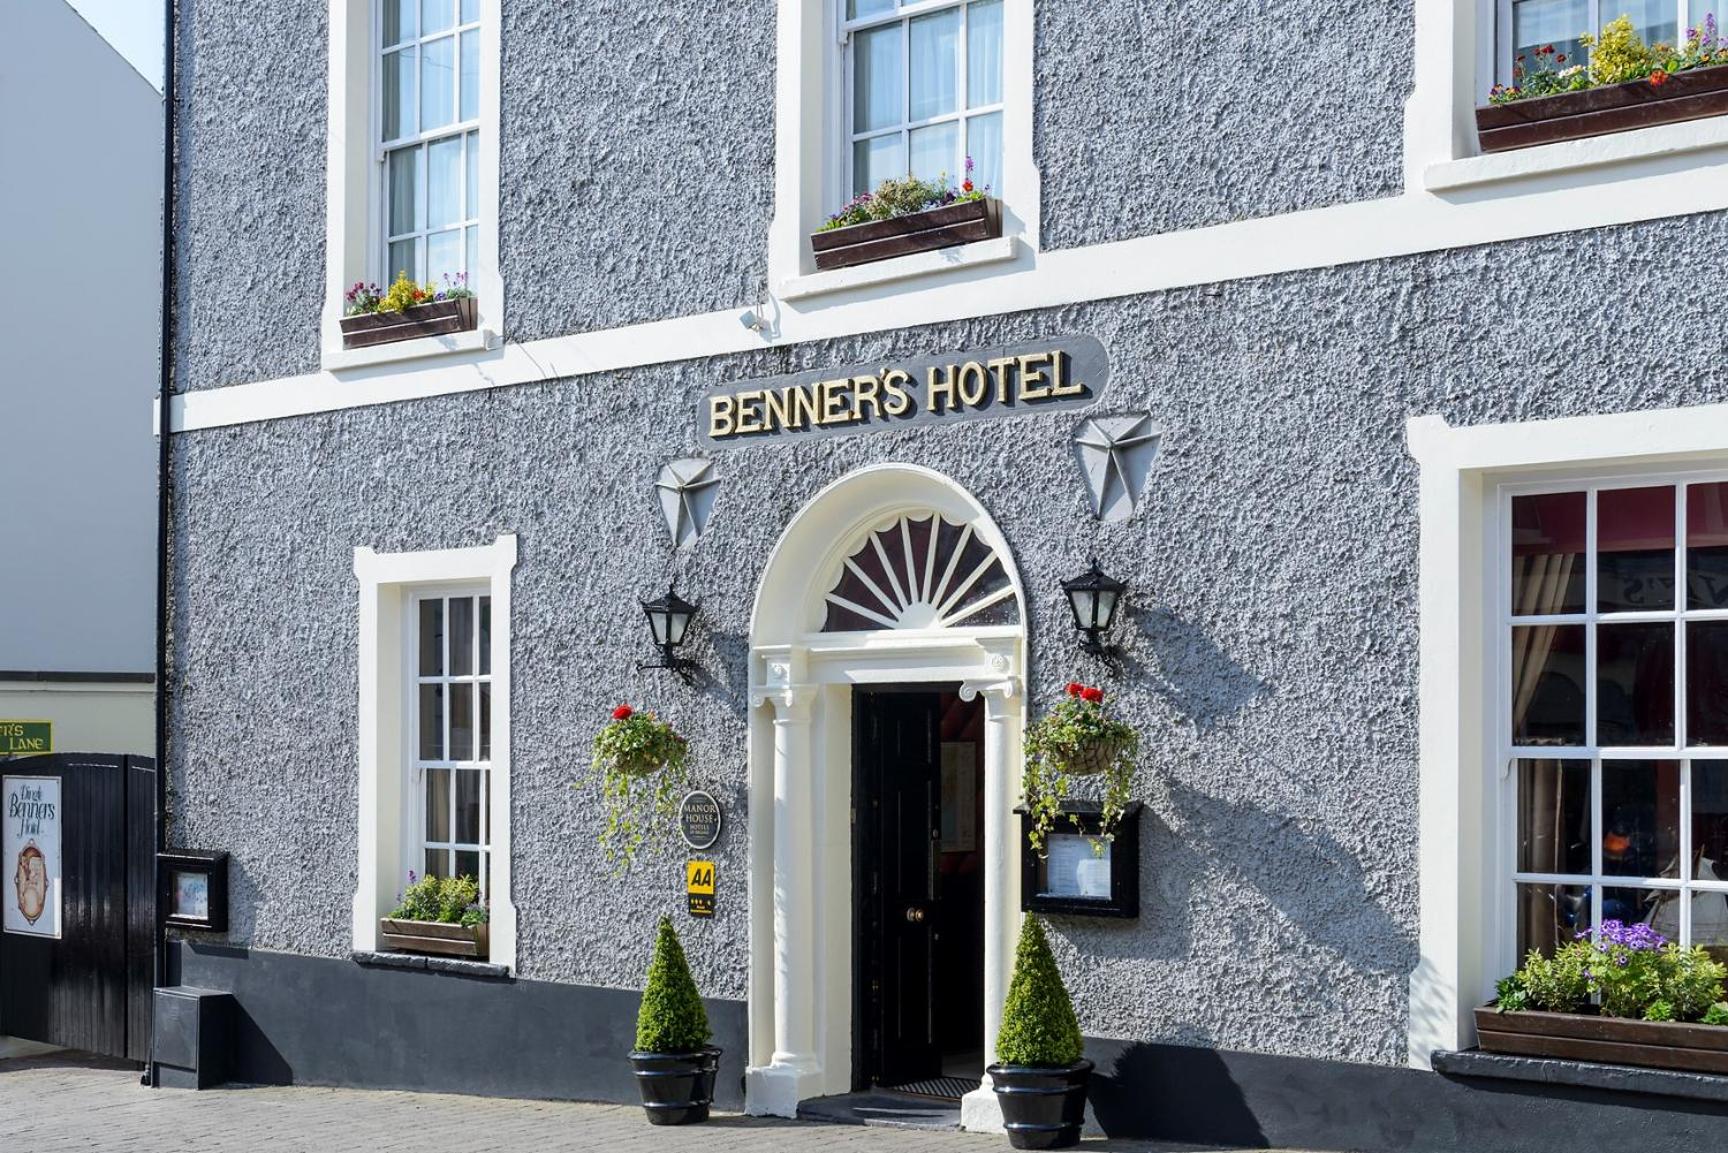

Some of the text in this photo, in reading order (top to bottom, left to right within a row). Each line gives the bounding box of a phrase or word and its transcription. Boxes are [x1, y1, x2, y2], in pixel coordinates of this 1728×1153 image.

[709, 350, 1084, 437] BENNER'S HOTEL
[10, 737, 43, 750] LANE
[684, 804, 716, 813] MANOR
[686, 814, 713, 823] HOUSE
[691, 868, 711, 886] AA
